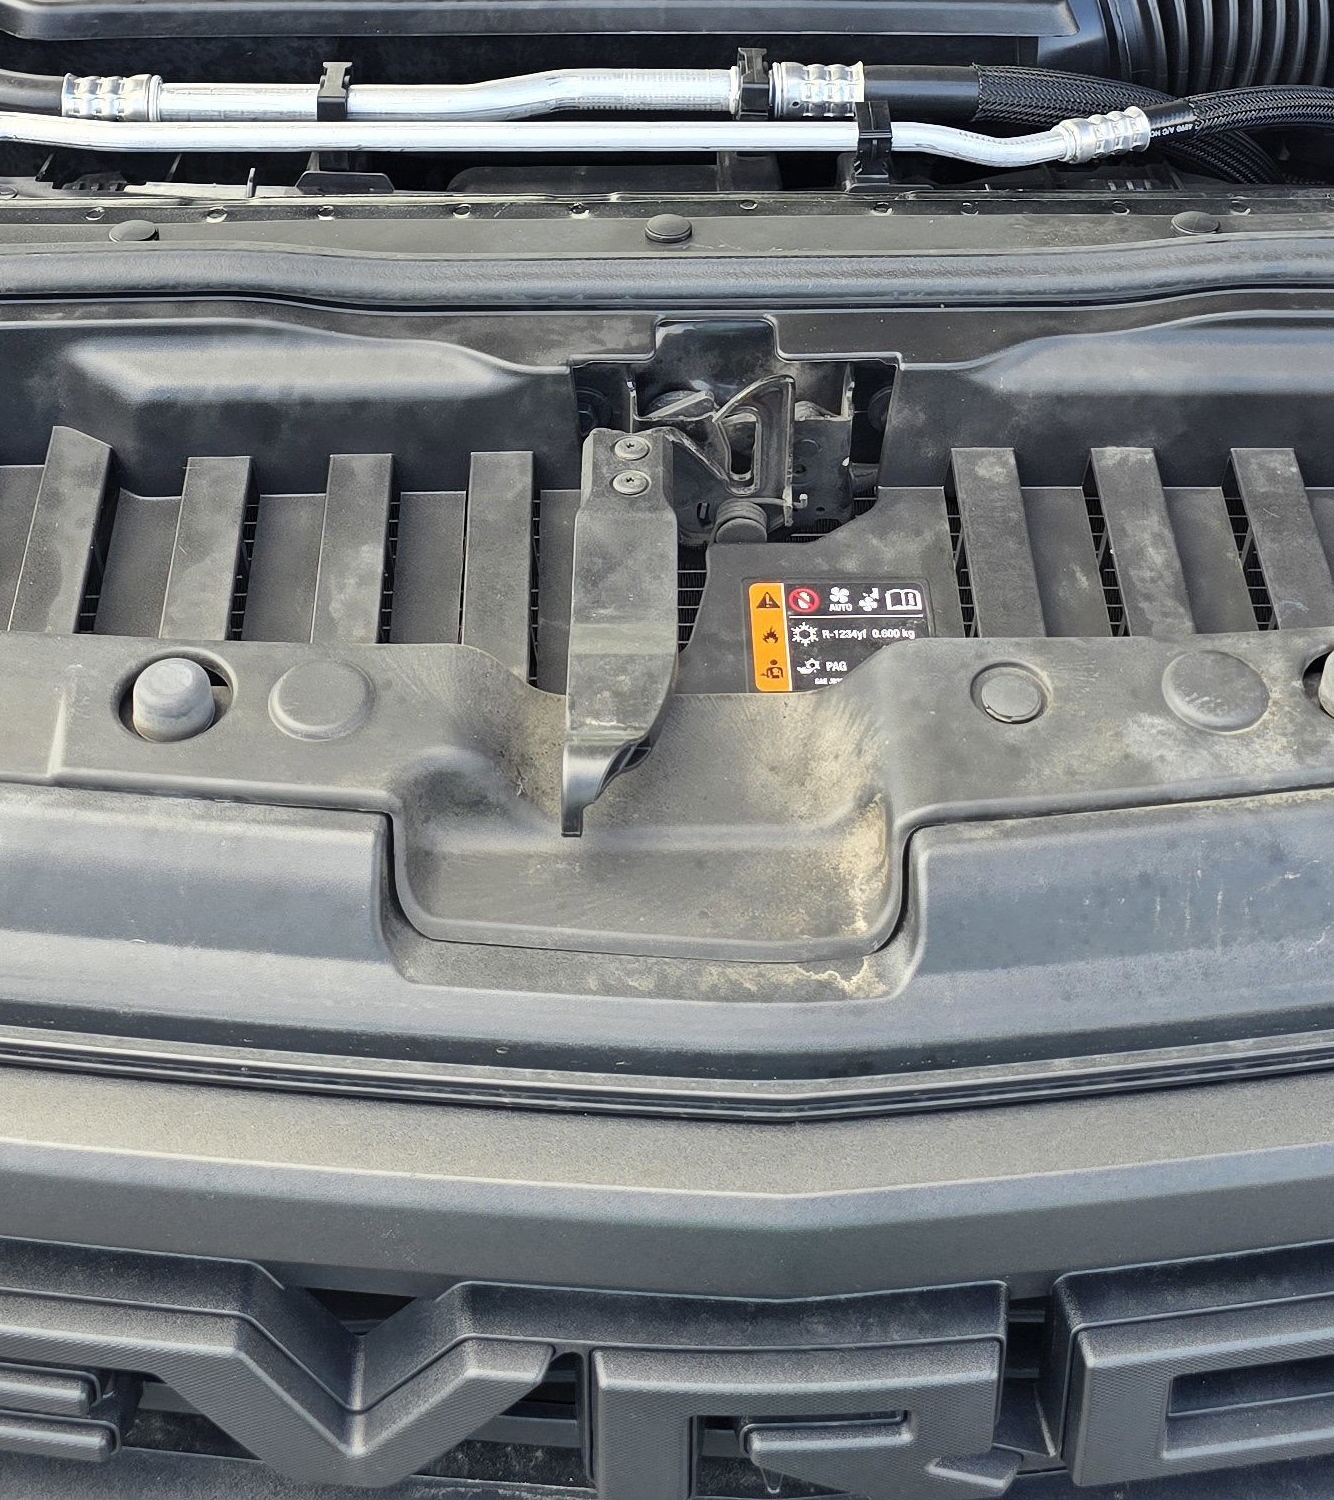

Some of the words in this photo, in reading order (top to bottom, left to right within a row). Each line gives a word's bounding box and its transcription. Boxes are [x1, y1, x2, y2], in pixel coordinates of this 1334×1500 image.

[829, 603, 853, 611] AUTO
[902, 629, 915, 639] kg
[826, 661, 847, 671] PAG
